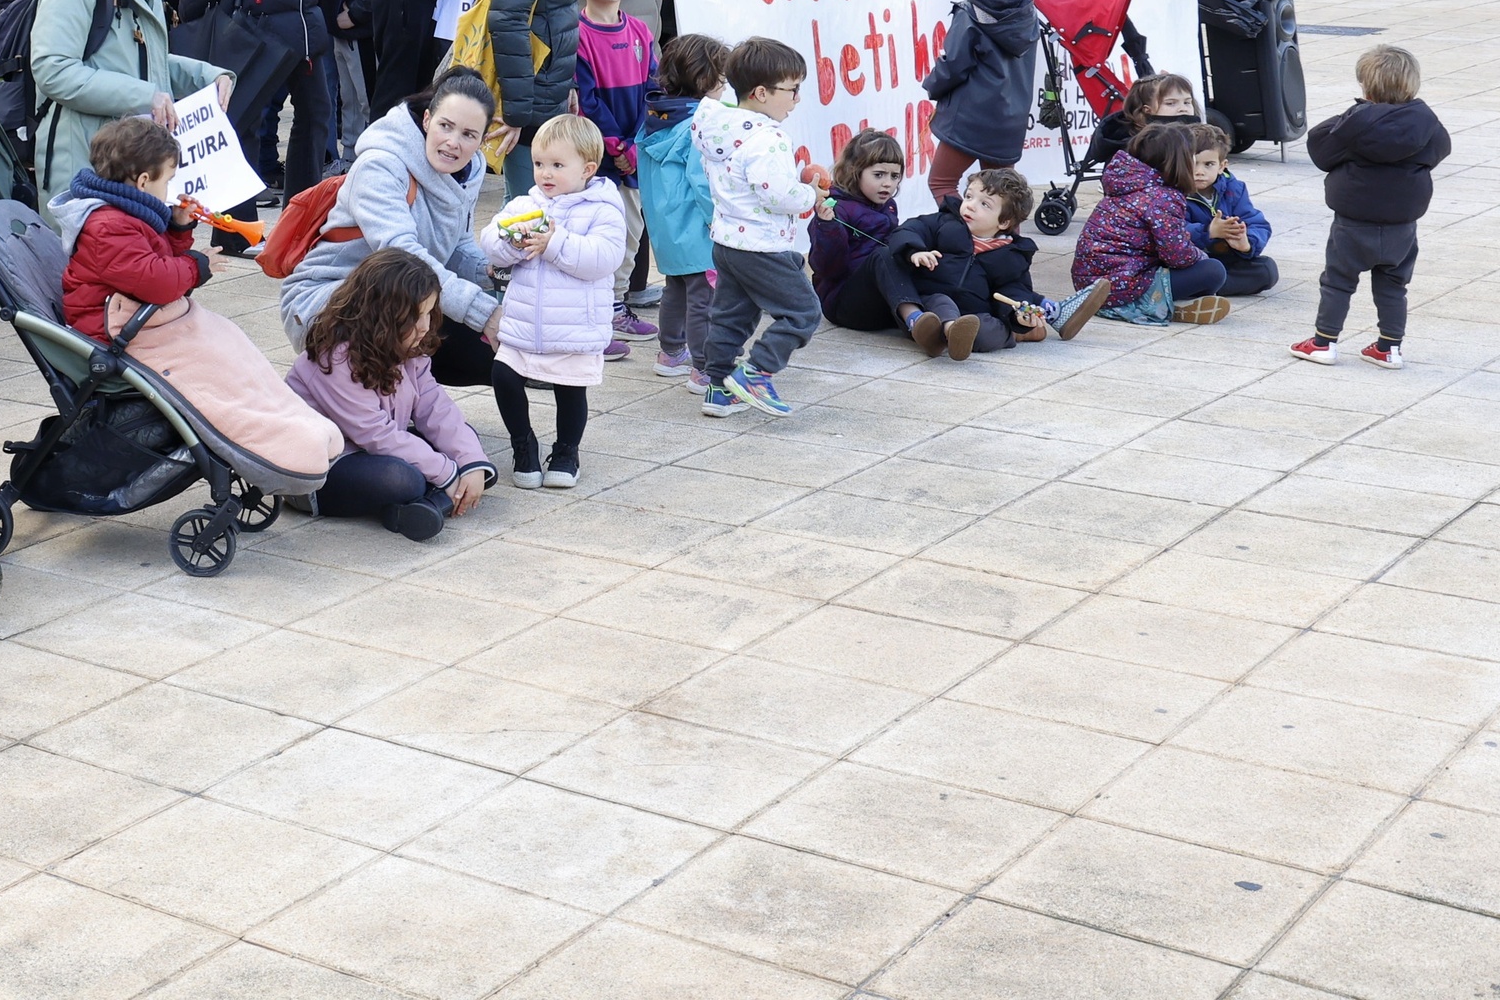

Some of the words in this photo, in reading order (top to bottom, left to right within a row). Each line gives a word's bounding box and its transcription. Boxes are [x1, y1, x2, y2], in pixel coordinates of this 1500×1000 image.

[811, 8, 899, 106] beti
[173, 103, 214, 137] MENDI
[178, 130, 229, 169] LTURA
[1022, 137, 1051, 150] ERRI
[184, 174, 209, 196] DA!
